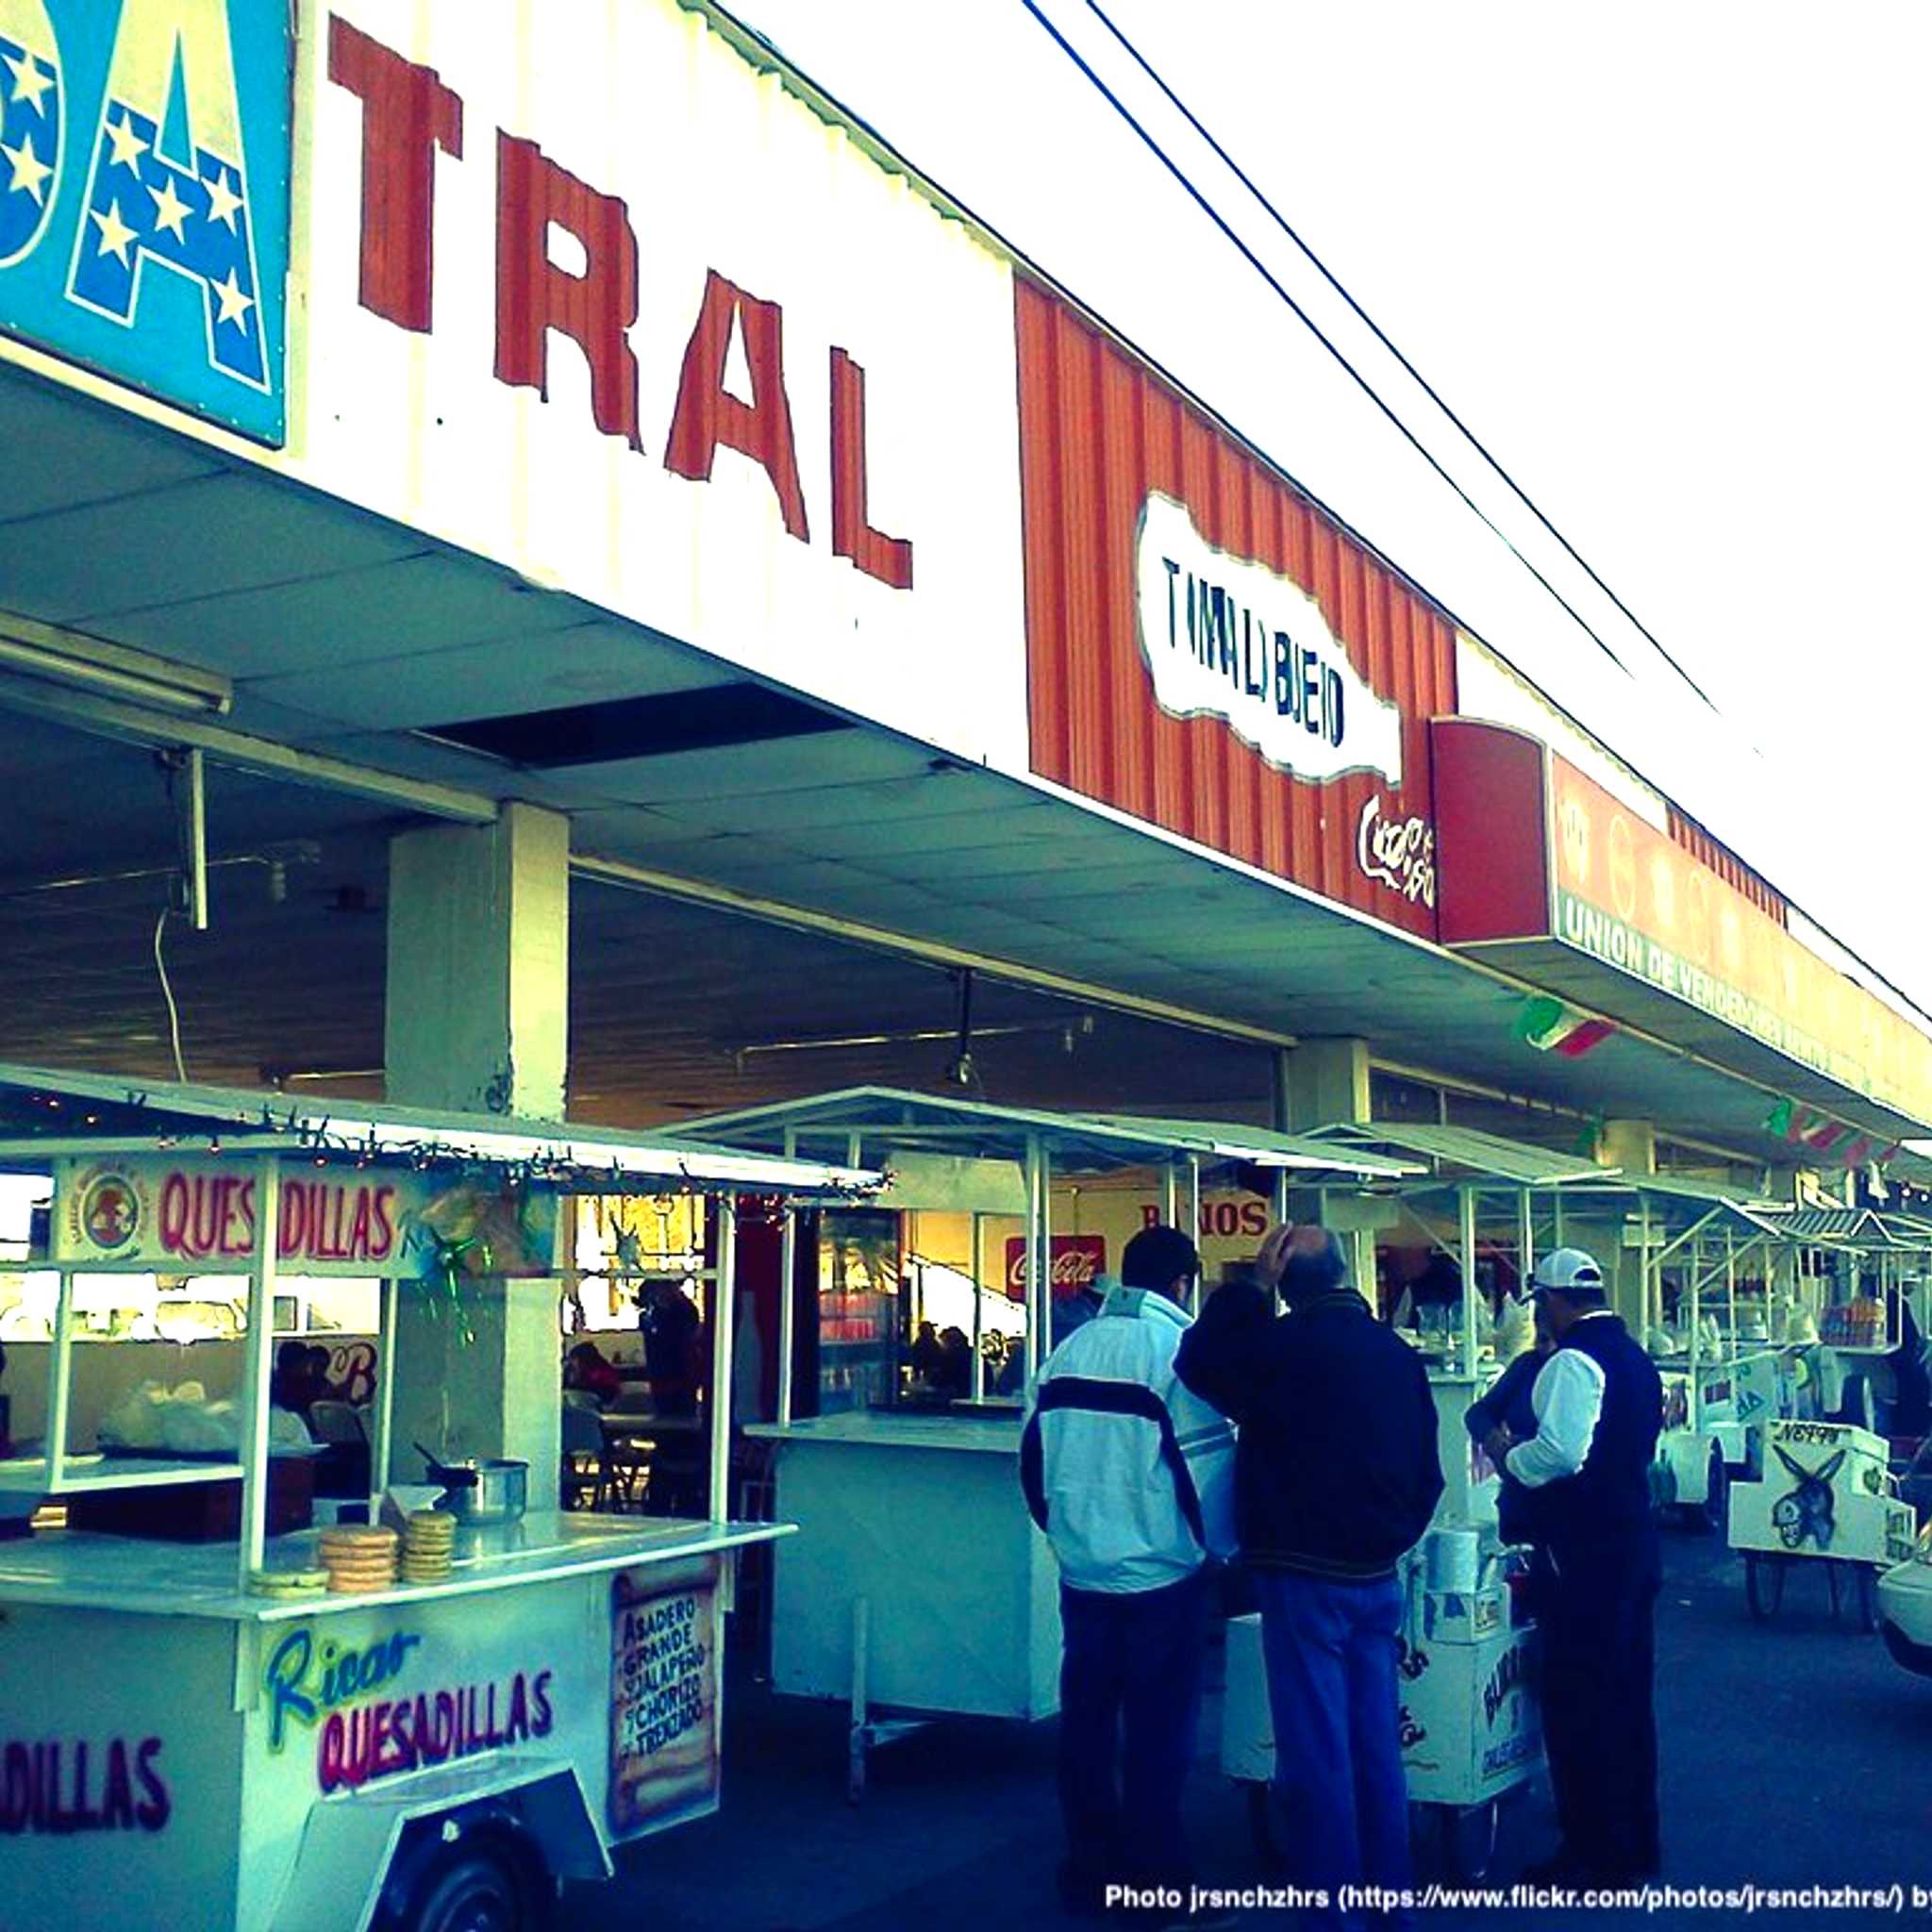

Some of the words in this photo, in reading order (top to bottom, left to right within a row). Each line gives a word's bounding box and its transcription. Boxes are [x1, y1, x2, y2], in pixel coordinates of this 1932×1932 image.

[1566, 898, 1643, 973] UNION
[1648, 945, 1675, 988] DE
[158, 1172, 394, 1261] QUESDILLAS
[1010, 1251, 1097, 1285] C-Cola
[623, 1623, 692, 1676] GRANDE
[624, 1598, 695, 1647] ASADERO
[318, 1670, 553, 1794] QUESADILLAS
[0, 1737, 172, 1835] DILLAS
